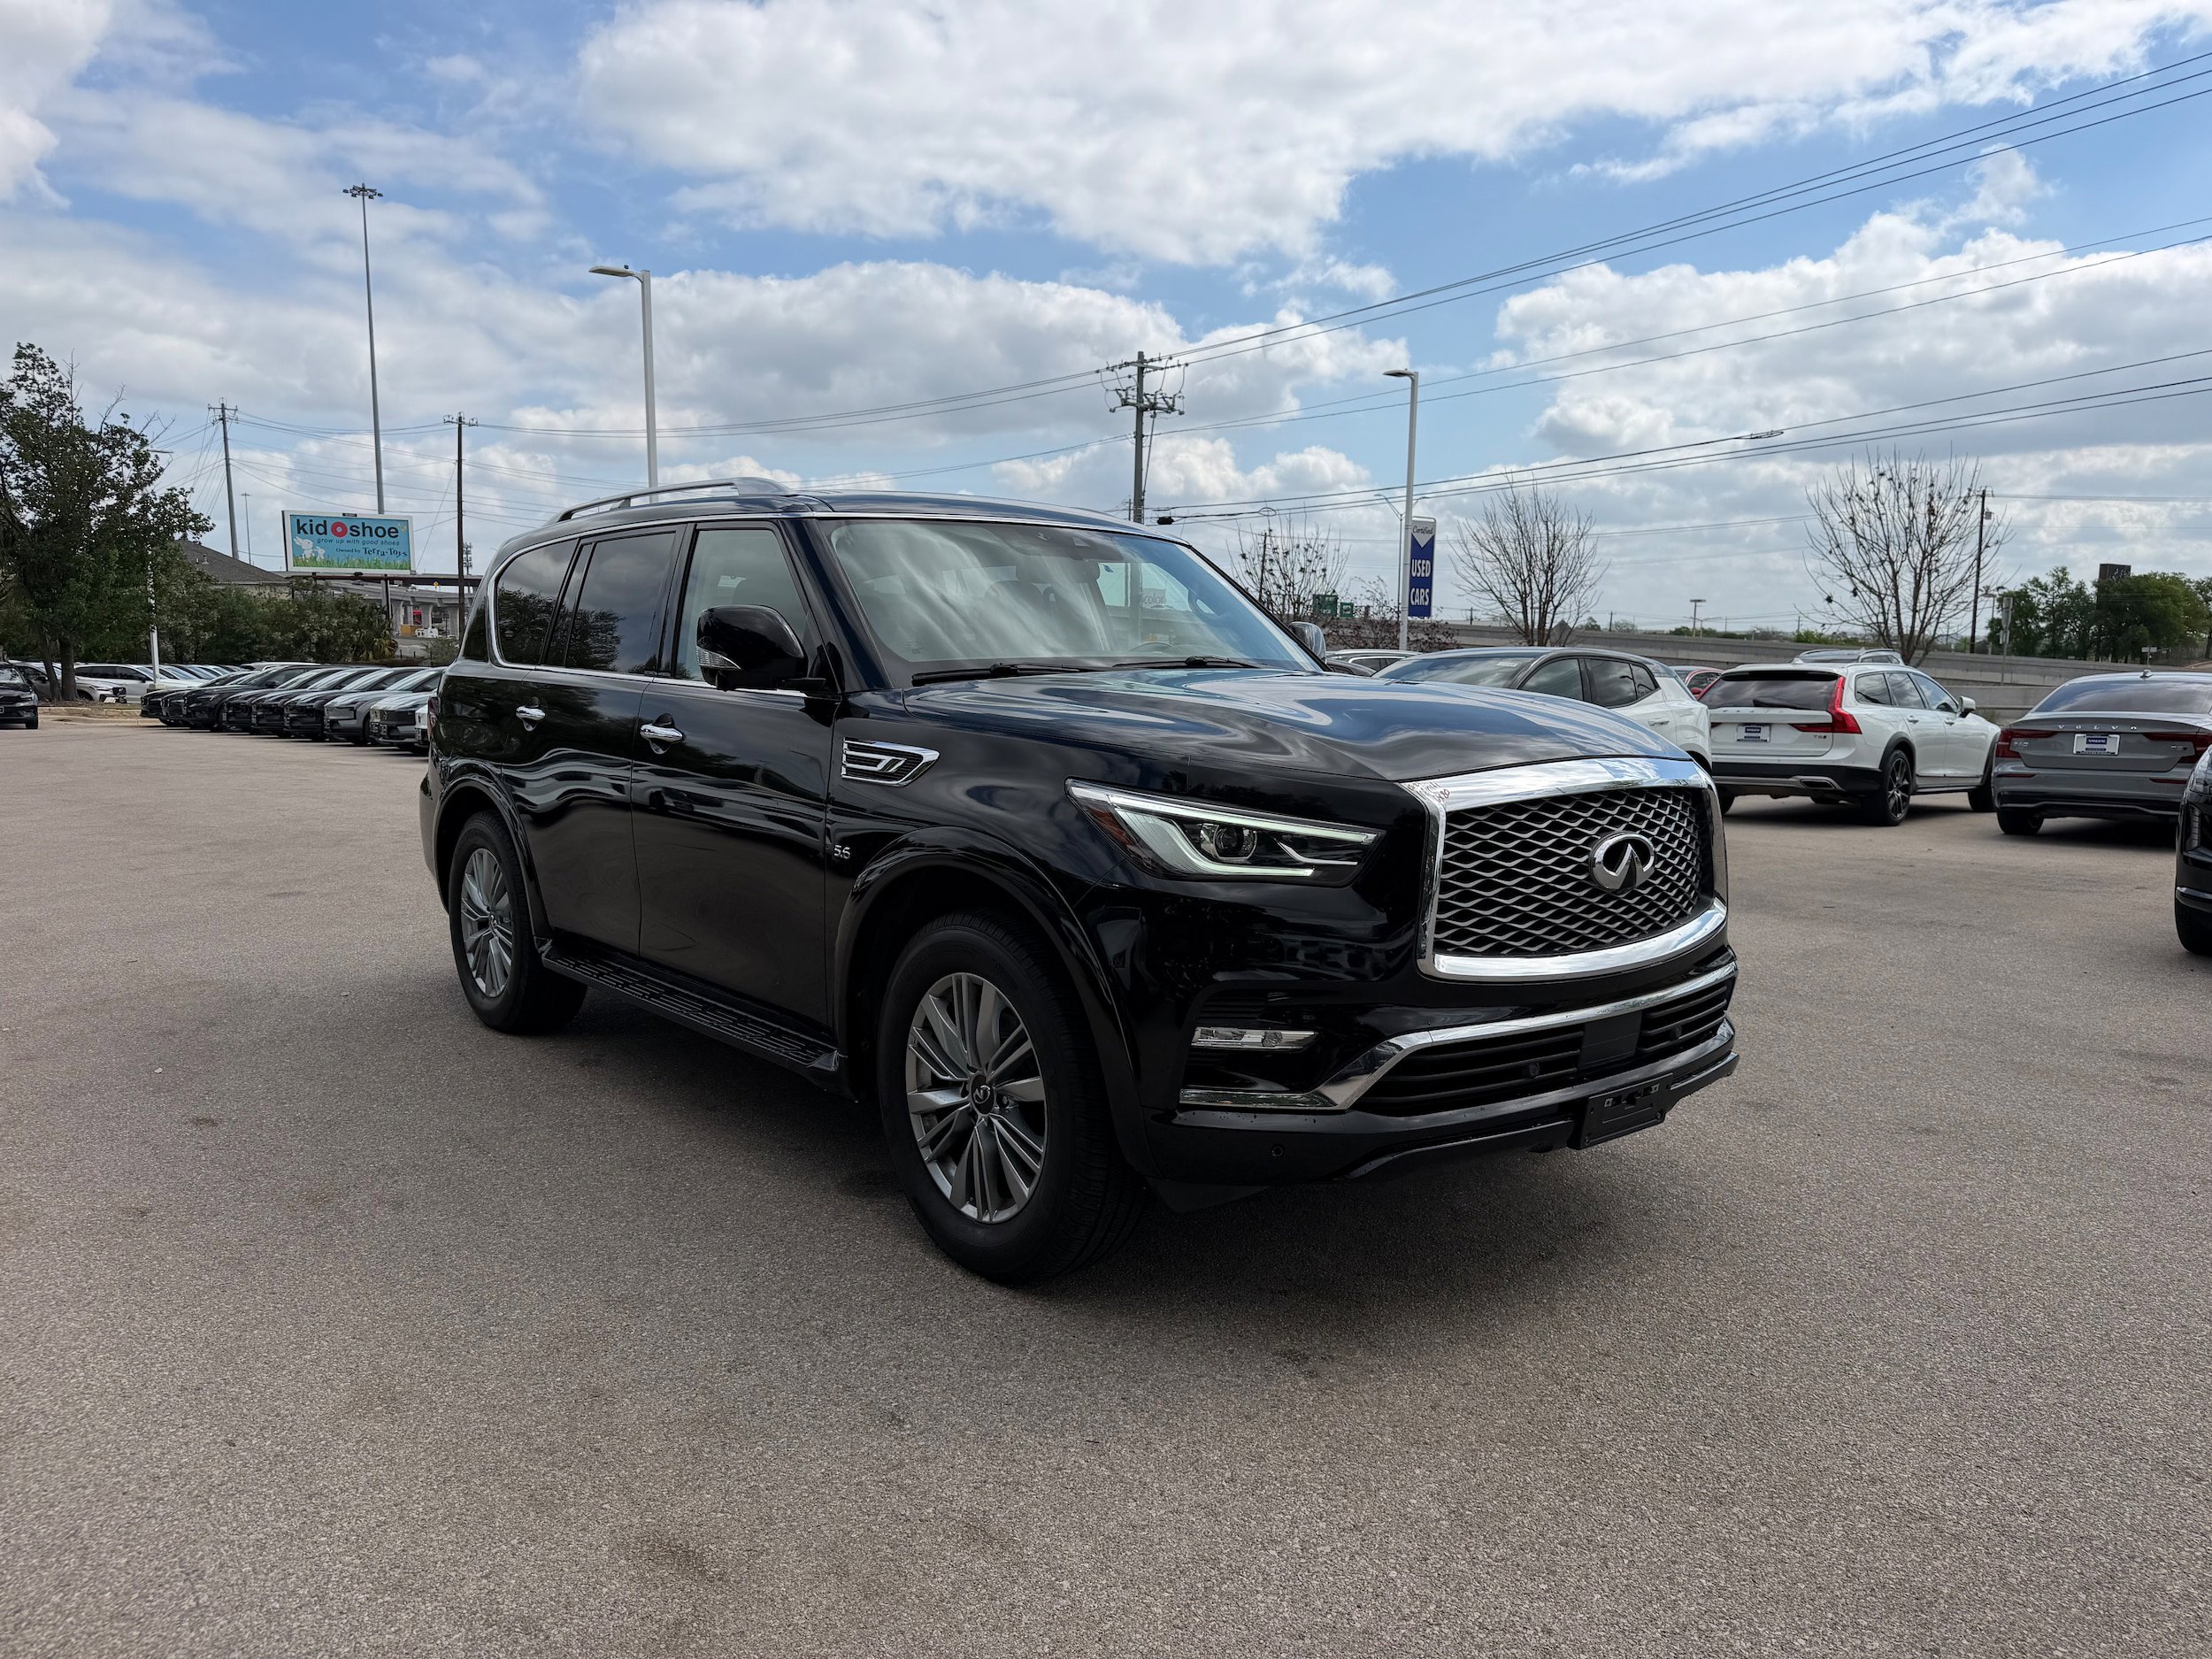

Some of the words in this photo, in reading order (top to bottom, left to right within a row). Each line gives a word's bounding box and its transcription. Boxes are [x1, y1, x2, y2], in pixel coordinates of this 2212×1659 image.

[1412, 526, 1433, 535] Certified
[1411, 558, 1431, 578] USED
[1410, 588, 1430, 606] CARS
[833, 844, 851, 860] 5.6
